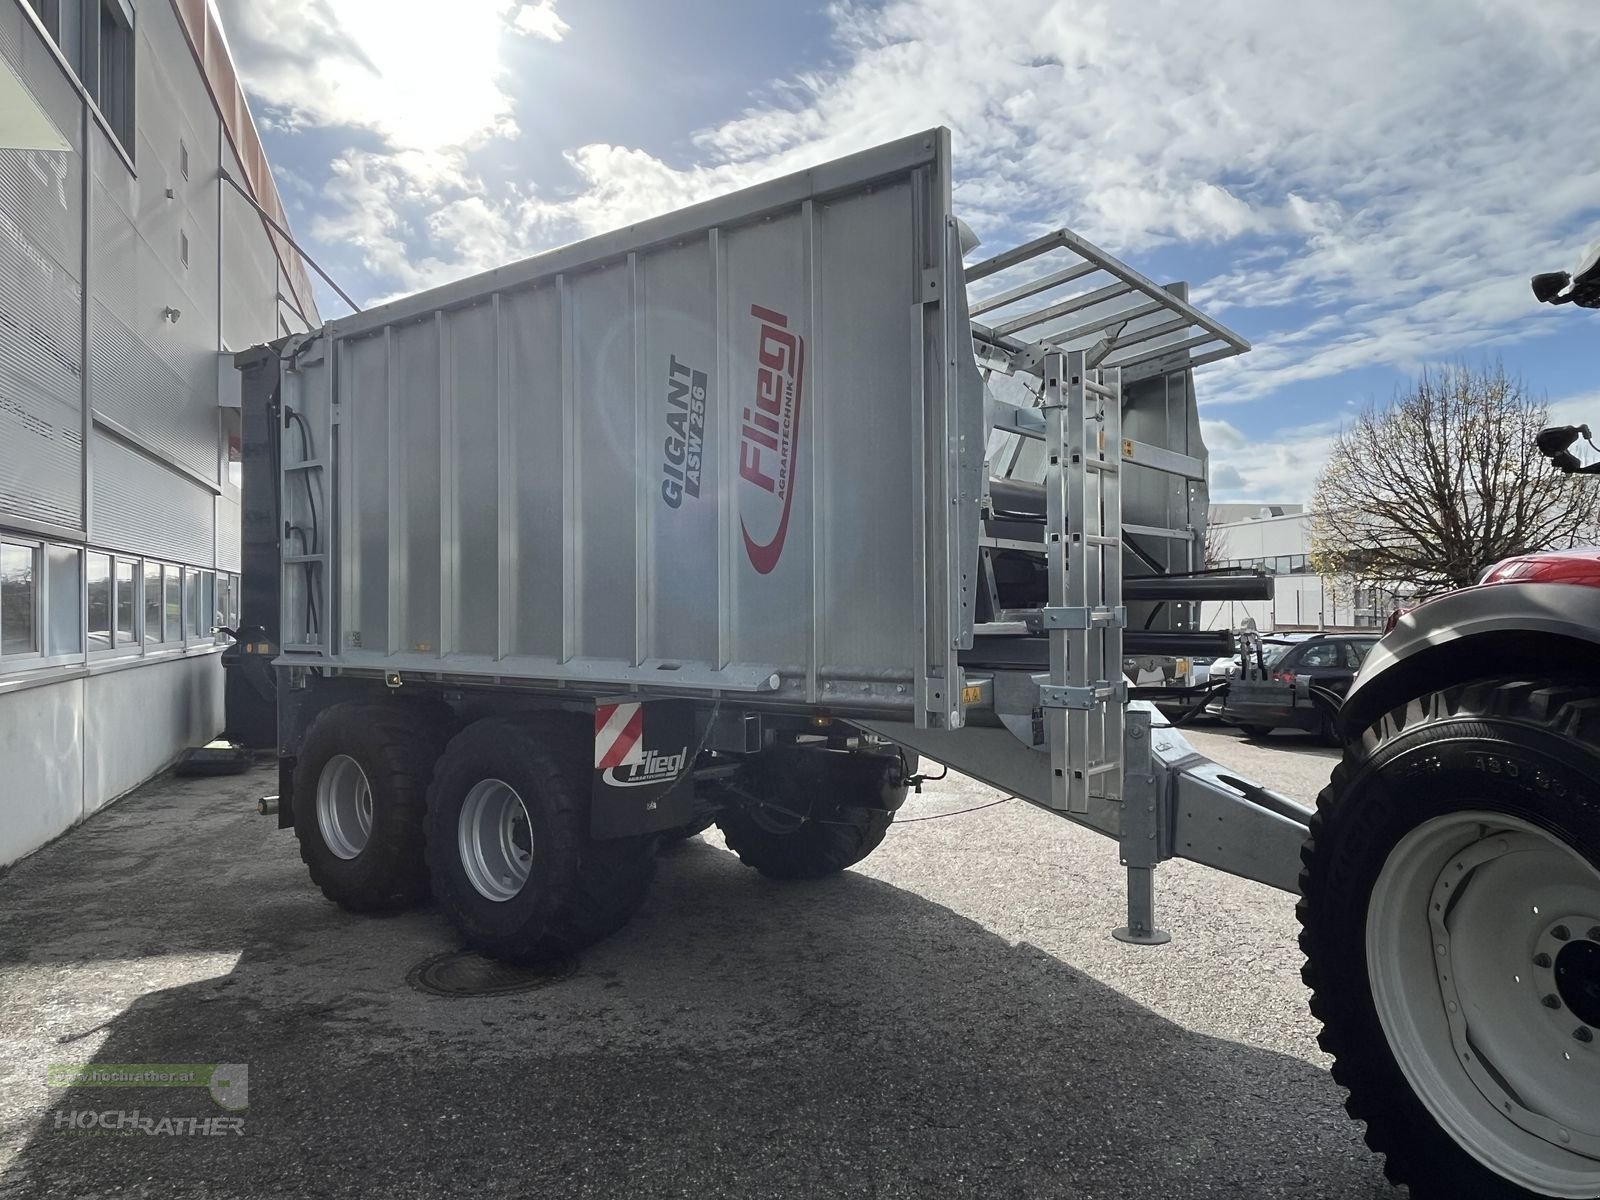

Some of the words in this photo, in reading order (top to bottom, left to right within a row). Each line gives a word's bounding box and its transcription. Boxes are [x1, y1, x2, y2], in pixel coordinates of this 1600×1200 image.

[661, 354, 691, 509] GIGANT
[691, 385, 705, 429] 256
[739, 304, 797, 493] Fliegl
[778, 379, 795, 501] AGRARTECHNIK
[687, 434, 702, 486] ASW
[629, 746, 688, 777] Fliegl
